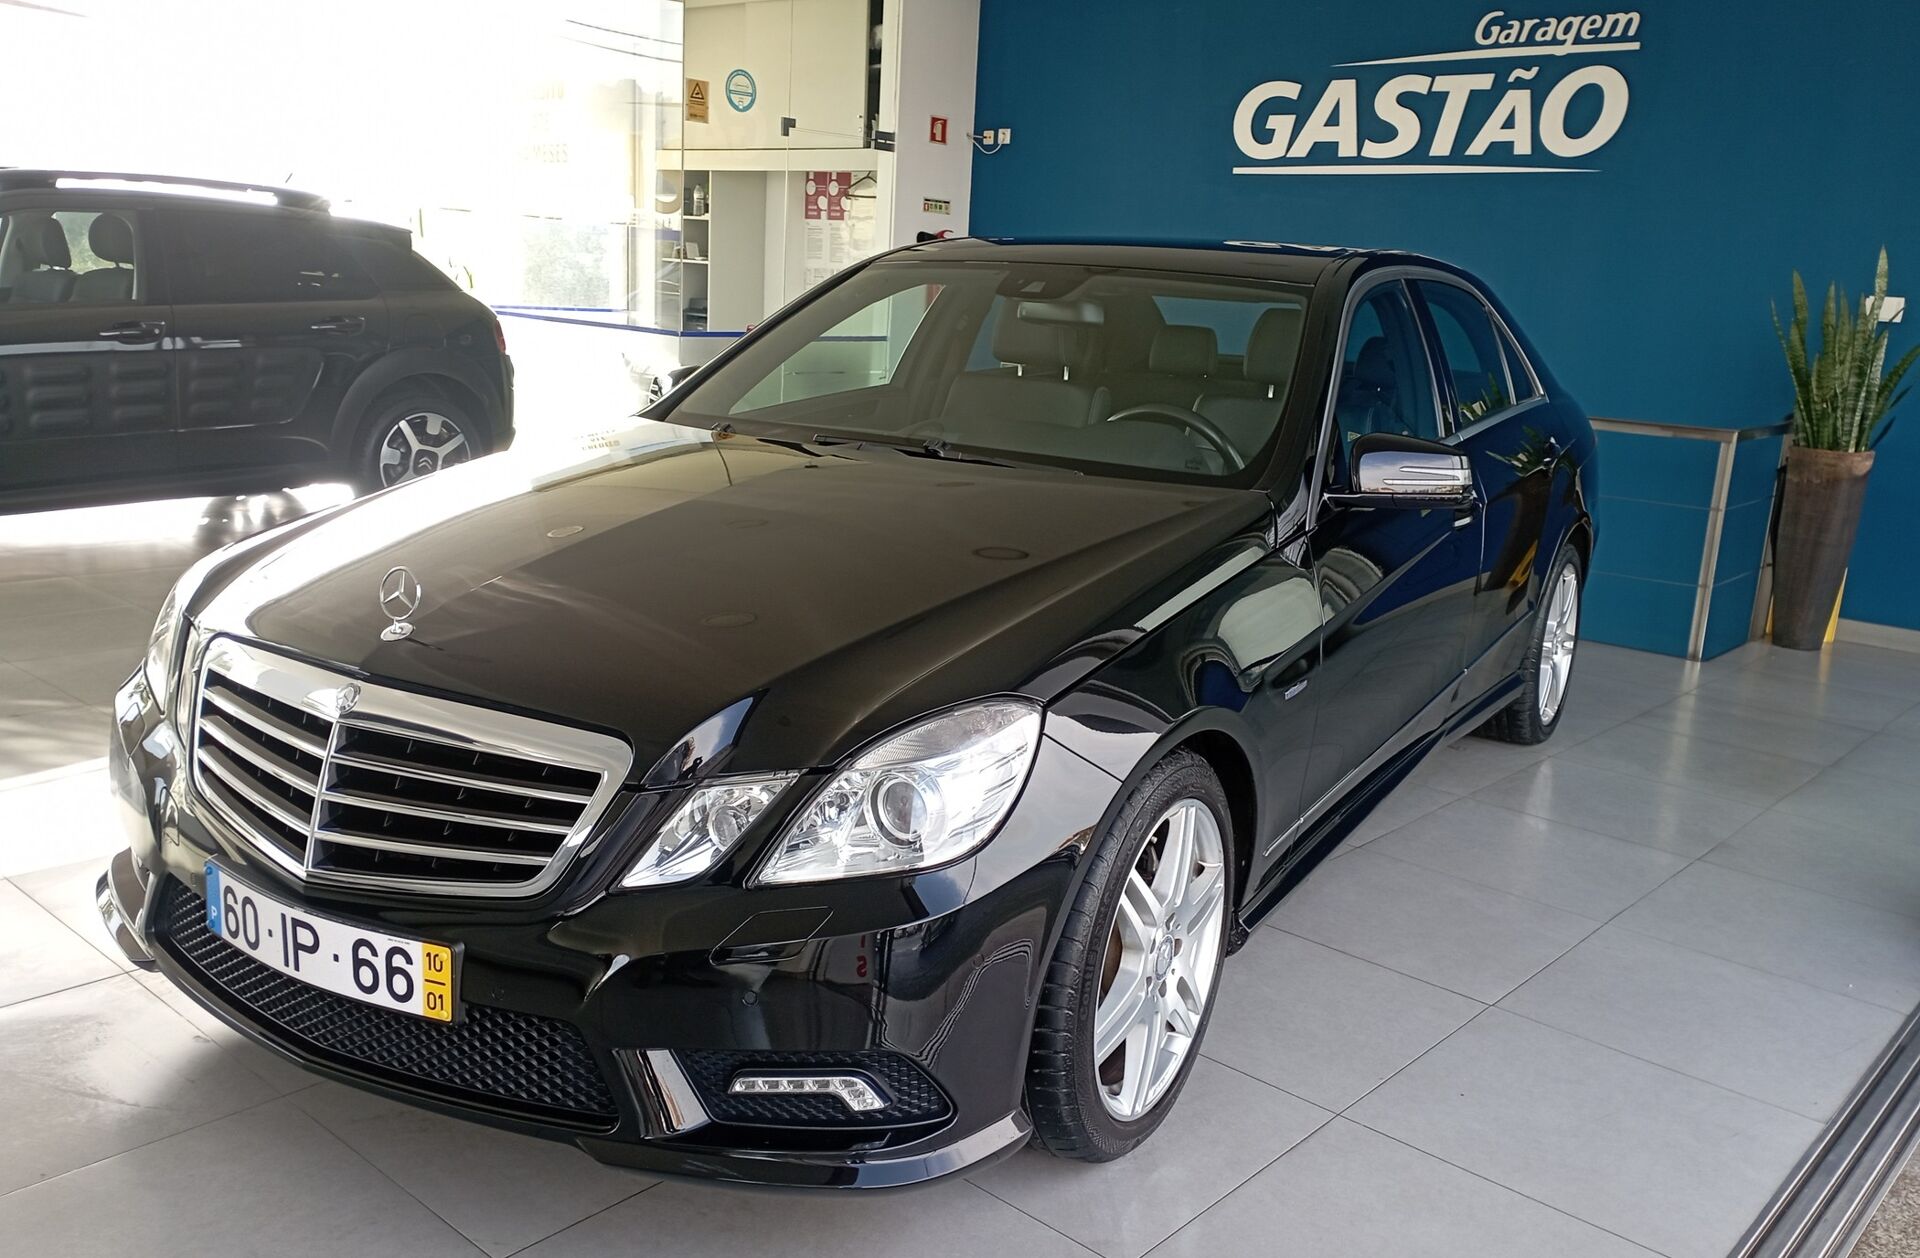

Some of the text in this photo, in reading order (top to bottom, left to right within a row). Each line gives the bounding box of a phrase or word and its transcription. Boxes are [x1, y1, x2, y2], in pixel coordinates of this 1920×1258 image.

[1475, 10, 1640, 56] Garagem
[1233, 65, 1629, 160] GASTÃO
[210, 906, 218, 920] P
[425, 951, 445, 973] 10
[426, 991, 444, 1011] 01
